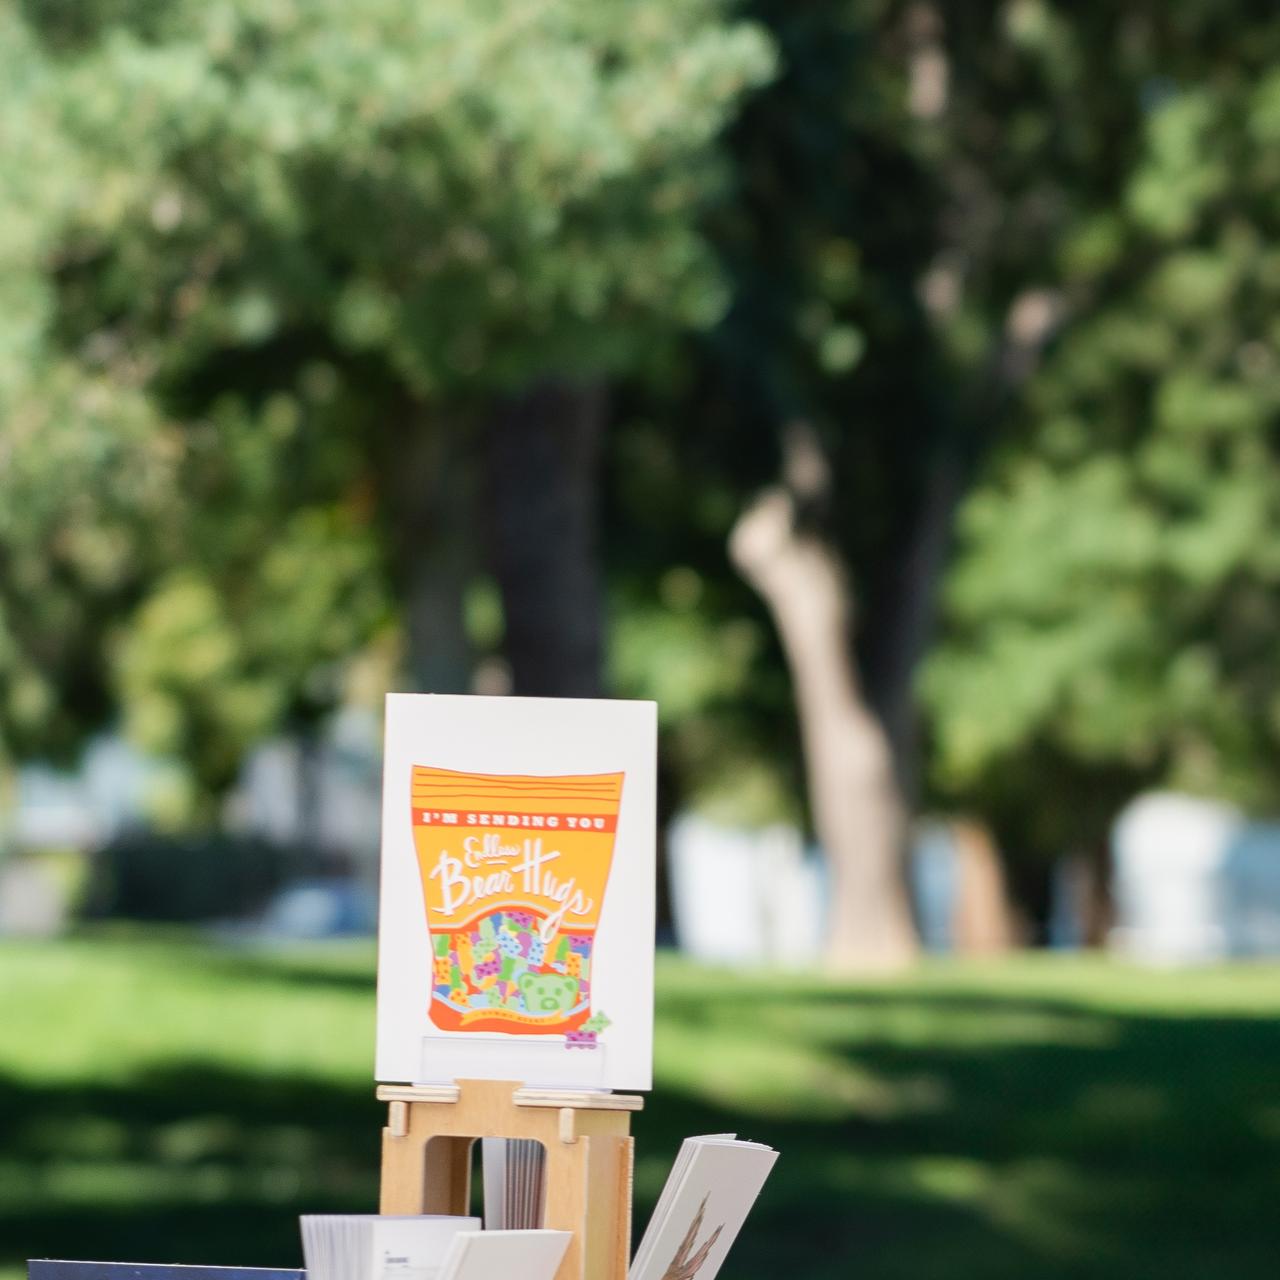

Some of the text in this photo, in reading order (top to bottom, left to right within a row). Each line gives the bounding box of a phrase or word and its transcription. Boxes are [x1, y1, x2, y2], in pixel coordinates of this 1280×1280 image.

[422, 811, 605, 829] I'M SENDING YOU
[429, 838, 593, 943] Bear Hugs
